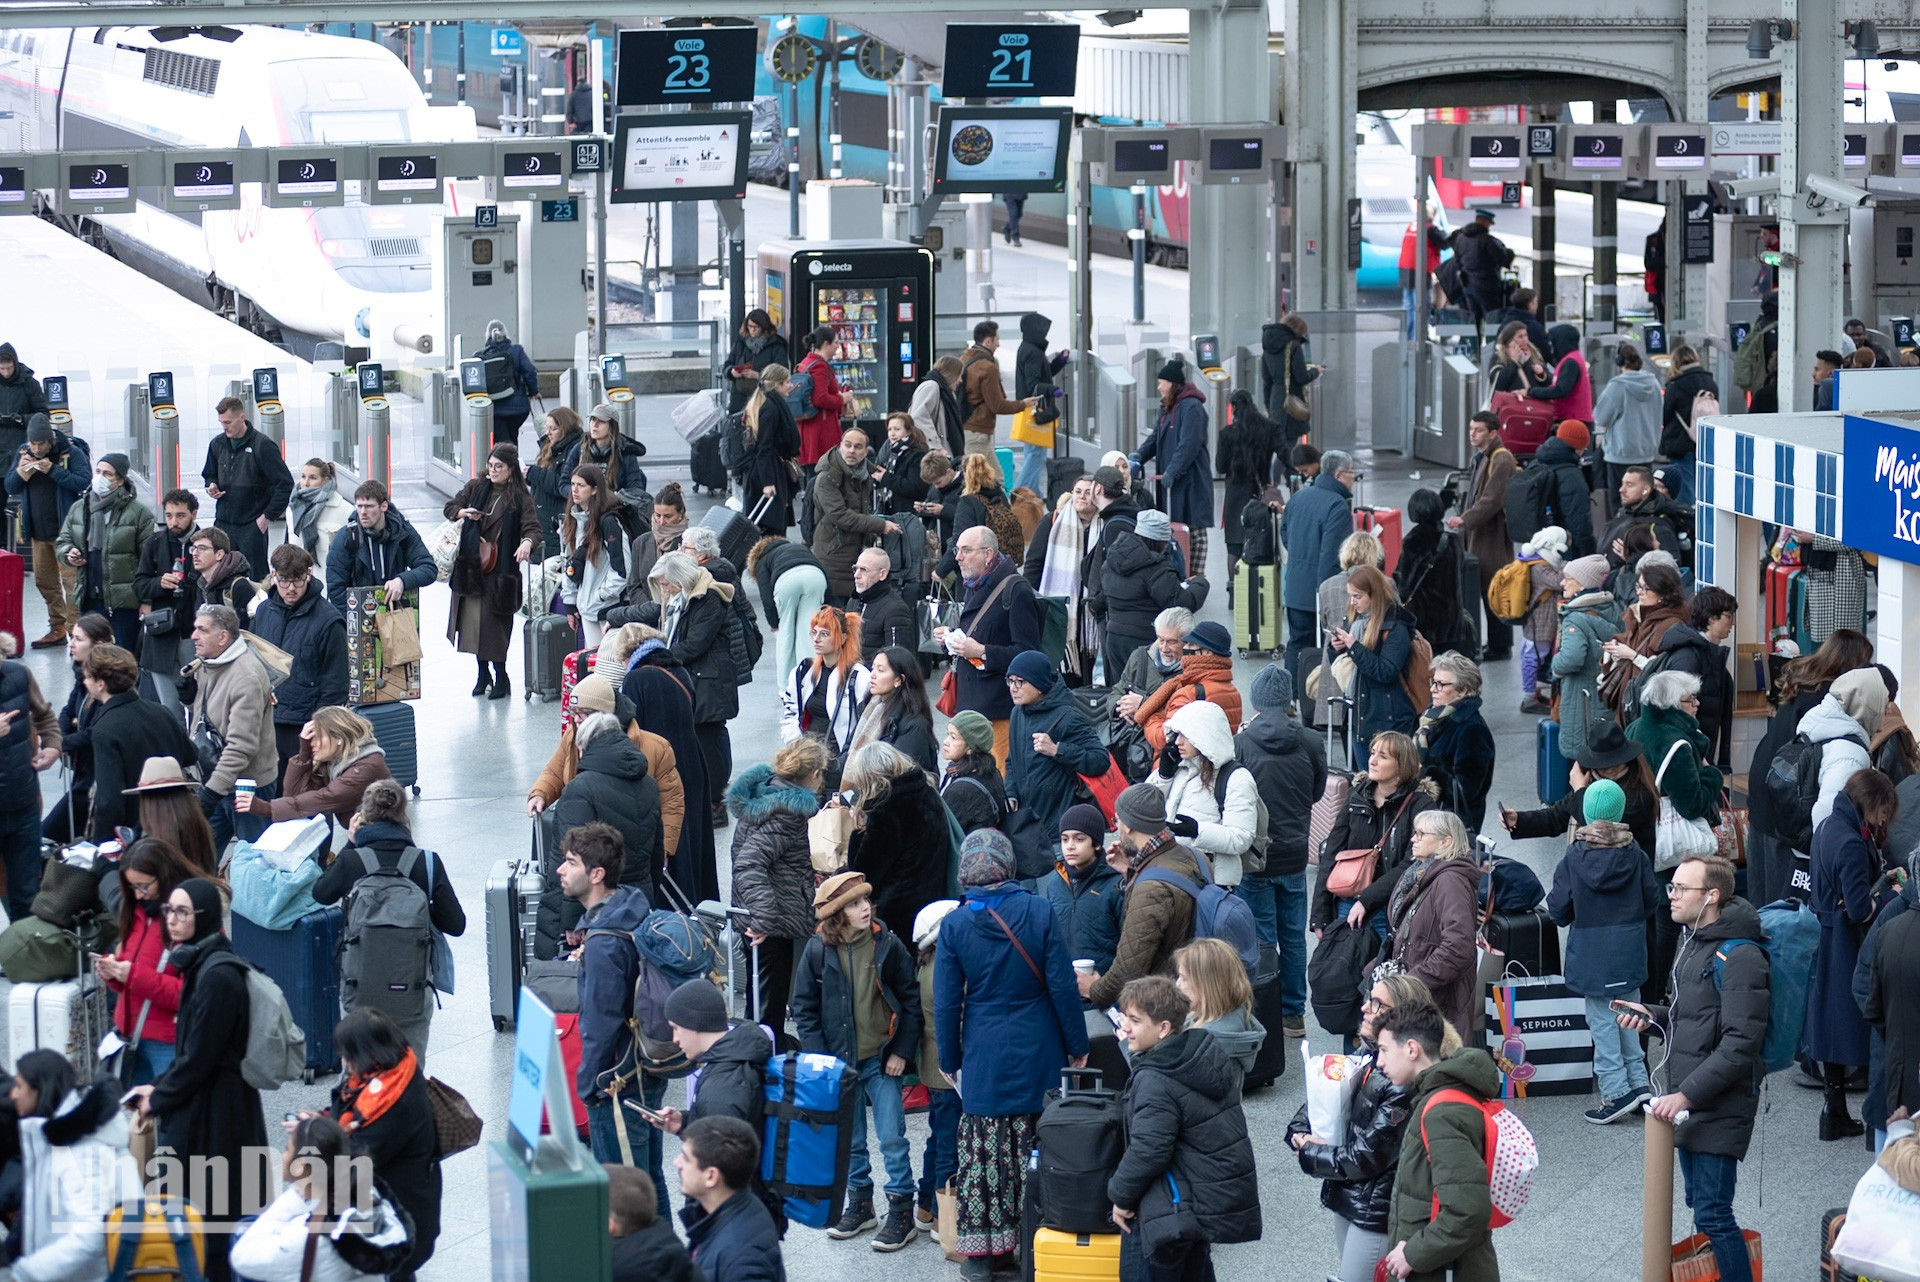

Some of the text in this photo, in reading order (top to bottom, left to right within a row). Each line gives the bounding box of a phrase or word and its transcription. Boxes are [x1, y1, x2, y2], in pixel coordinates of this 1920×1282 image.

[1003, 35, 1025, 45] Voie
[678, 41, 701, 50] Voie
[989, 49, 1032, 81] 21
[665, 54, 710, 87] 23
[636, 136, 672, 144] Attentifs
[675, 134, 711, 142] ensemble
[554, 204, 572, 218] 23
[823, 263, 853, 272] selecta
[1522, 1019, 1571, 1030] SEPHORA
